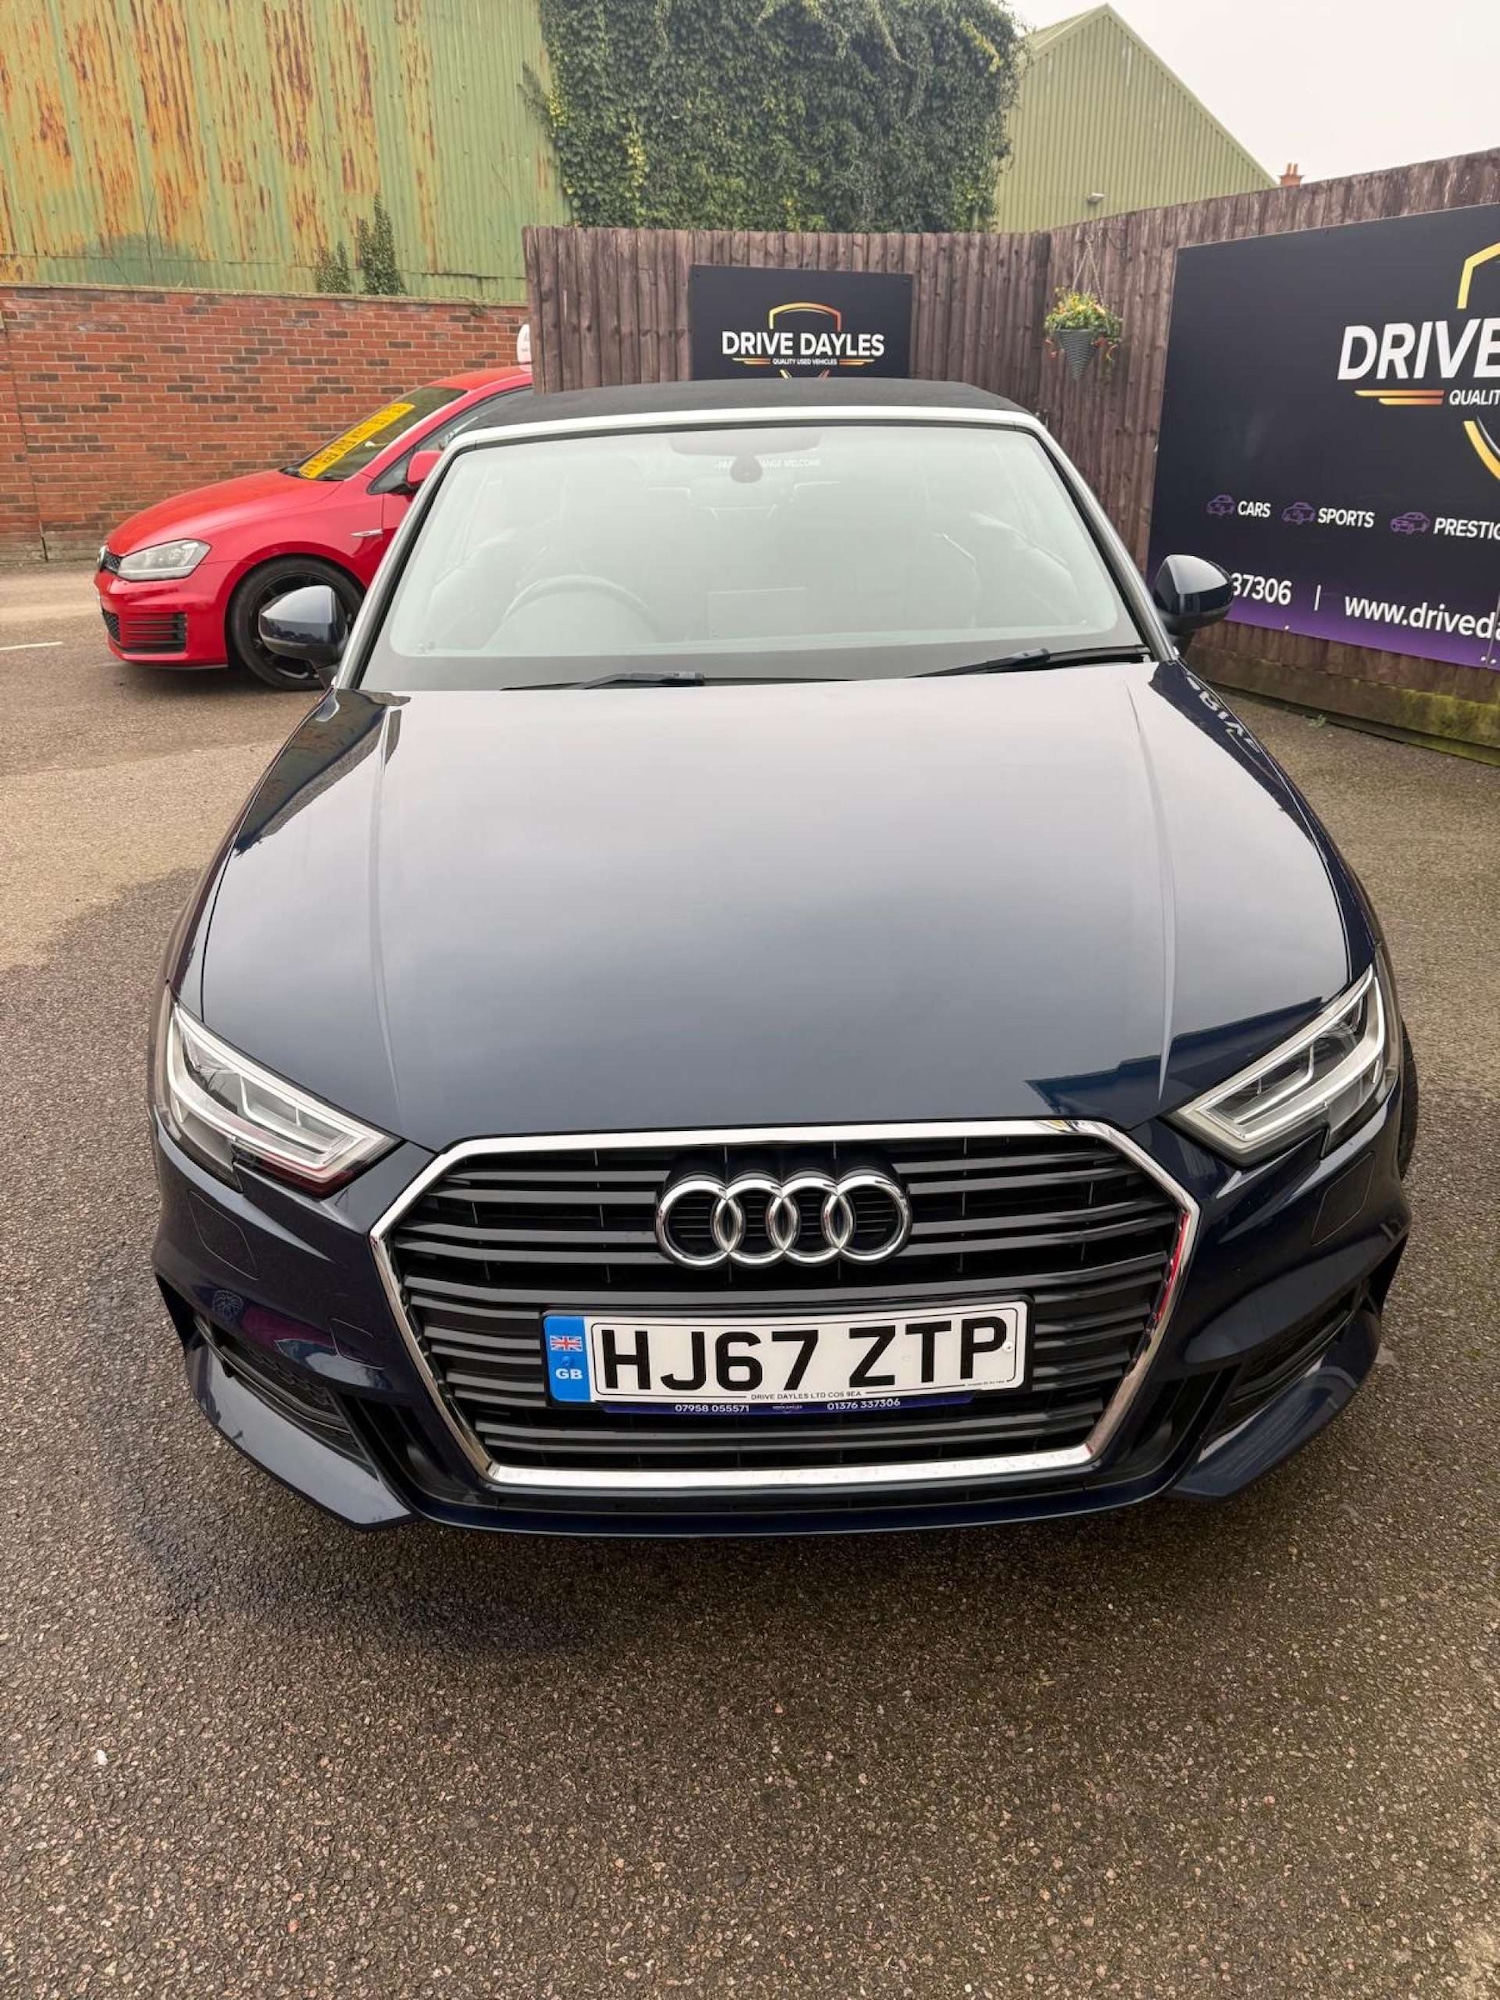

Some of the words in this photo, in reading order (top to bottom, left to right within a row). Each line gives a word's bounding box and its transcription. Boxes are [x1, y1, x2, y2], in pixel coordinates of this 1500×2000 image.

[722, 331, 794, 355] DRIVE
[800, 332, 885, 356] DAYLES
[1337, 317, 1500, 380] DRIVE
[772, 357, 796, 365] QUALITY
[812, 358, 838, 366] VEHICLES
[1237, 500, 1272, 518] CARS
[1318, 508, 1375, 529] SPORTS
[1230, 572, 1293, 605] 37306
[601, 1329, 819, 1391] HJ67
[849, 1315, 1007, 1388] ZTP
[555, 1367, 583, 1380] GB
[674, 1404, 709, 1412] 07958
[711, 1404, 750, 1413] 055571
[826, 1402, 859, 1411] 01376
[860, 1398, 901, 1409] 337306
[777, 1392, 809, 1400] DAYLES
